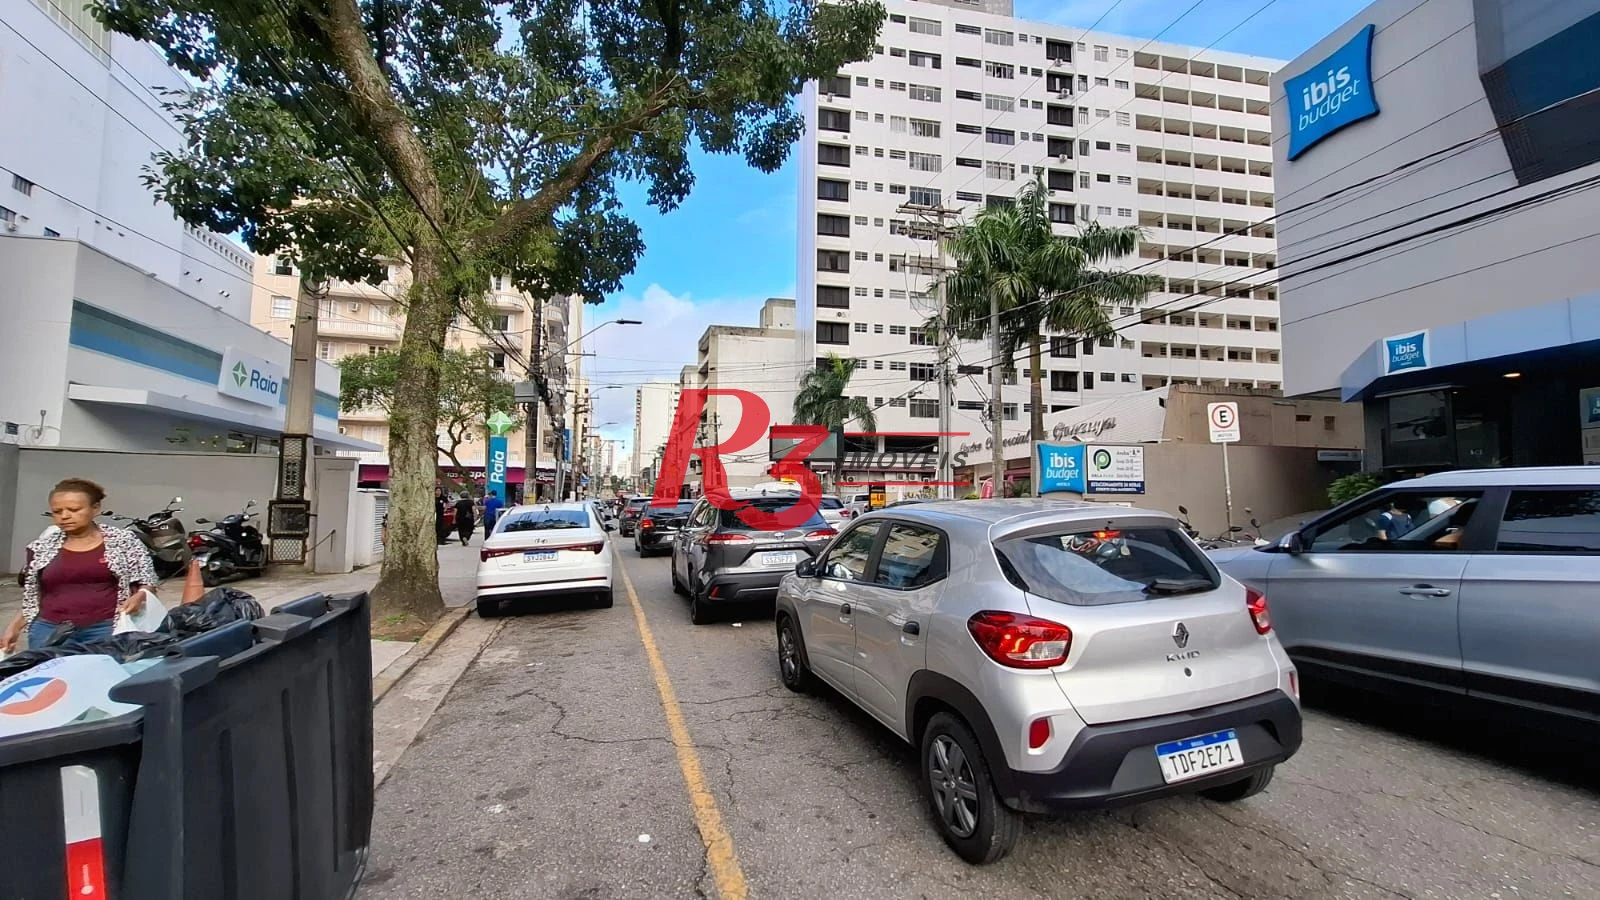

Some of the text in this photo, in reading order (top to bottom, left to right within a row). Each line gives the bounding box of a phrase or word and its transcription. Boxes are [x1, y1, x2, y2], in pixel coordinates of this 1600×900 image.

[1303, 66, 1350, 111] ibis
[1299, 80, 1360, 131] budget
[1395, 343, 1417, 355] ibis
[1392, 352, 1420, 362] budget
[250, 369, 278, 394] Raia
[1219, 410, 1228, 423] E
[491, 450, 505, 483] Raia
[1050, 453, 1076, 468] ibis
[1046, 468, 1080, 480] budget
[1166, 651, 1200, 662] KWID
[1169, 743, 1235, 775] TDF2E71
